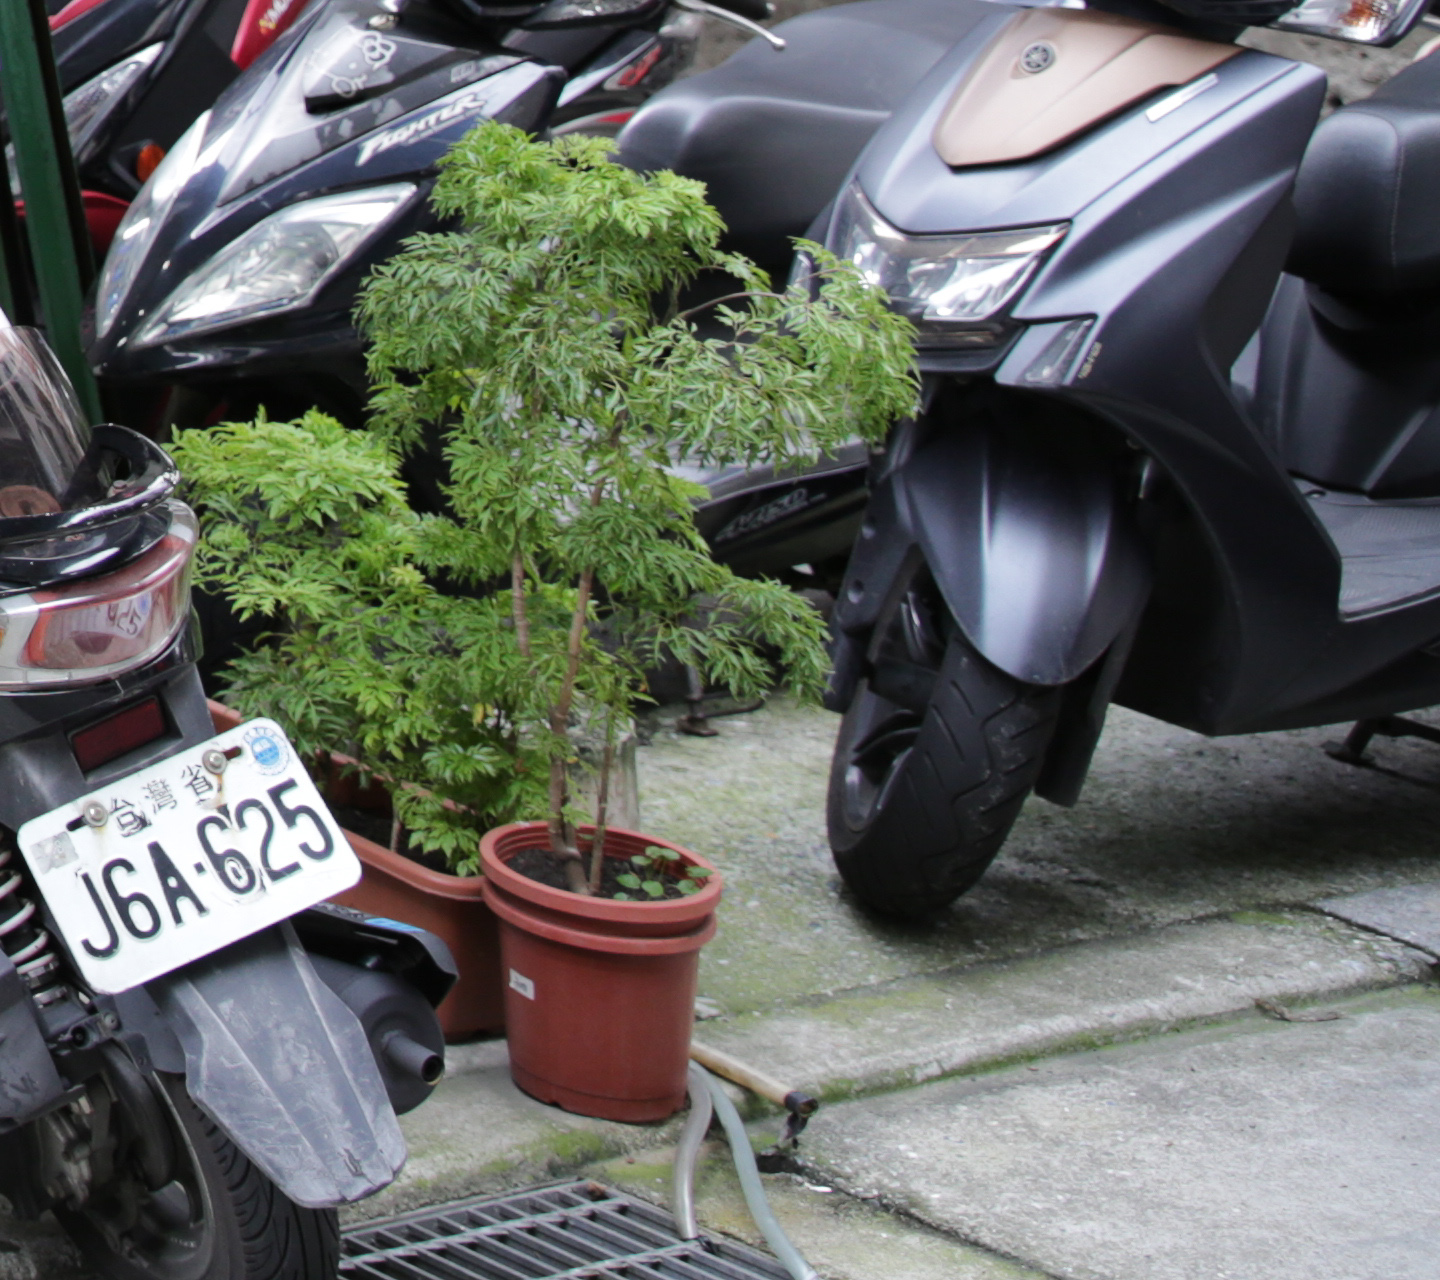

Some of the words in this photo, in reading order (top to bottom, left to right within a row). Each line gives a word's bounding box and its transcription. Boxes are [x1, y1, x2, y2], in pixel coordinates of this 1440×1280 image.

[355, 93, 487, 167] FIGHTER
[110, 764, 220, 837] 台灣省
